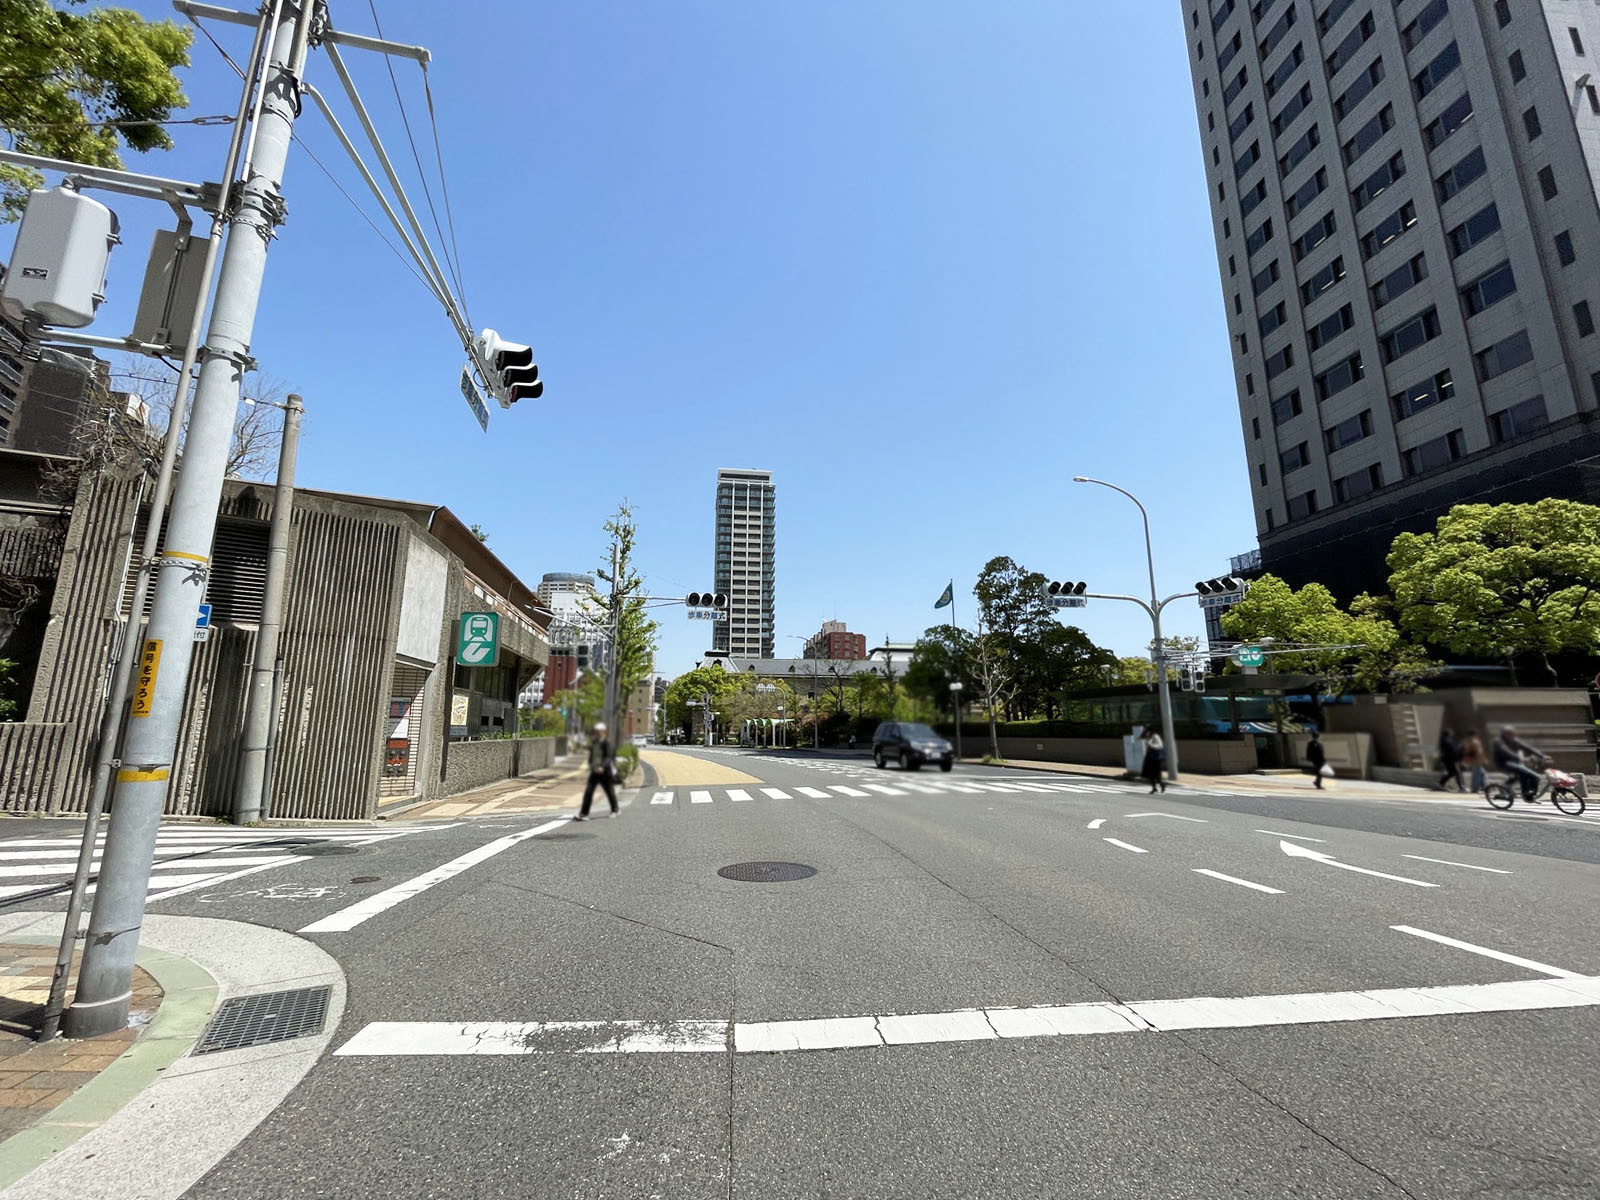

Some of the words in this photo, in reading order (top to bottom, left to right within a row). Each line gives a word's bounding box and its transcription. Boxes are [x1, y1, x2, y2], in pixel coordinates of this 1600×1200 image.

[136, 641, 158, 710] 信号を守ろう
